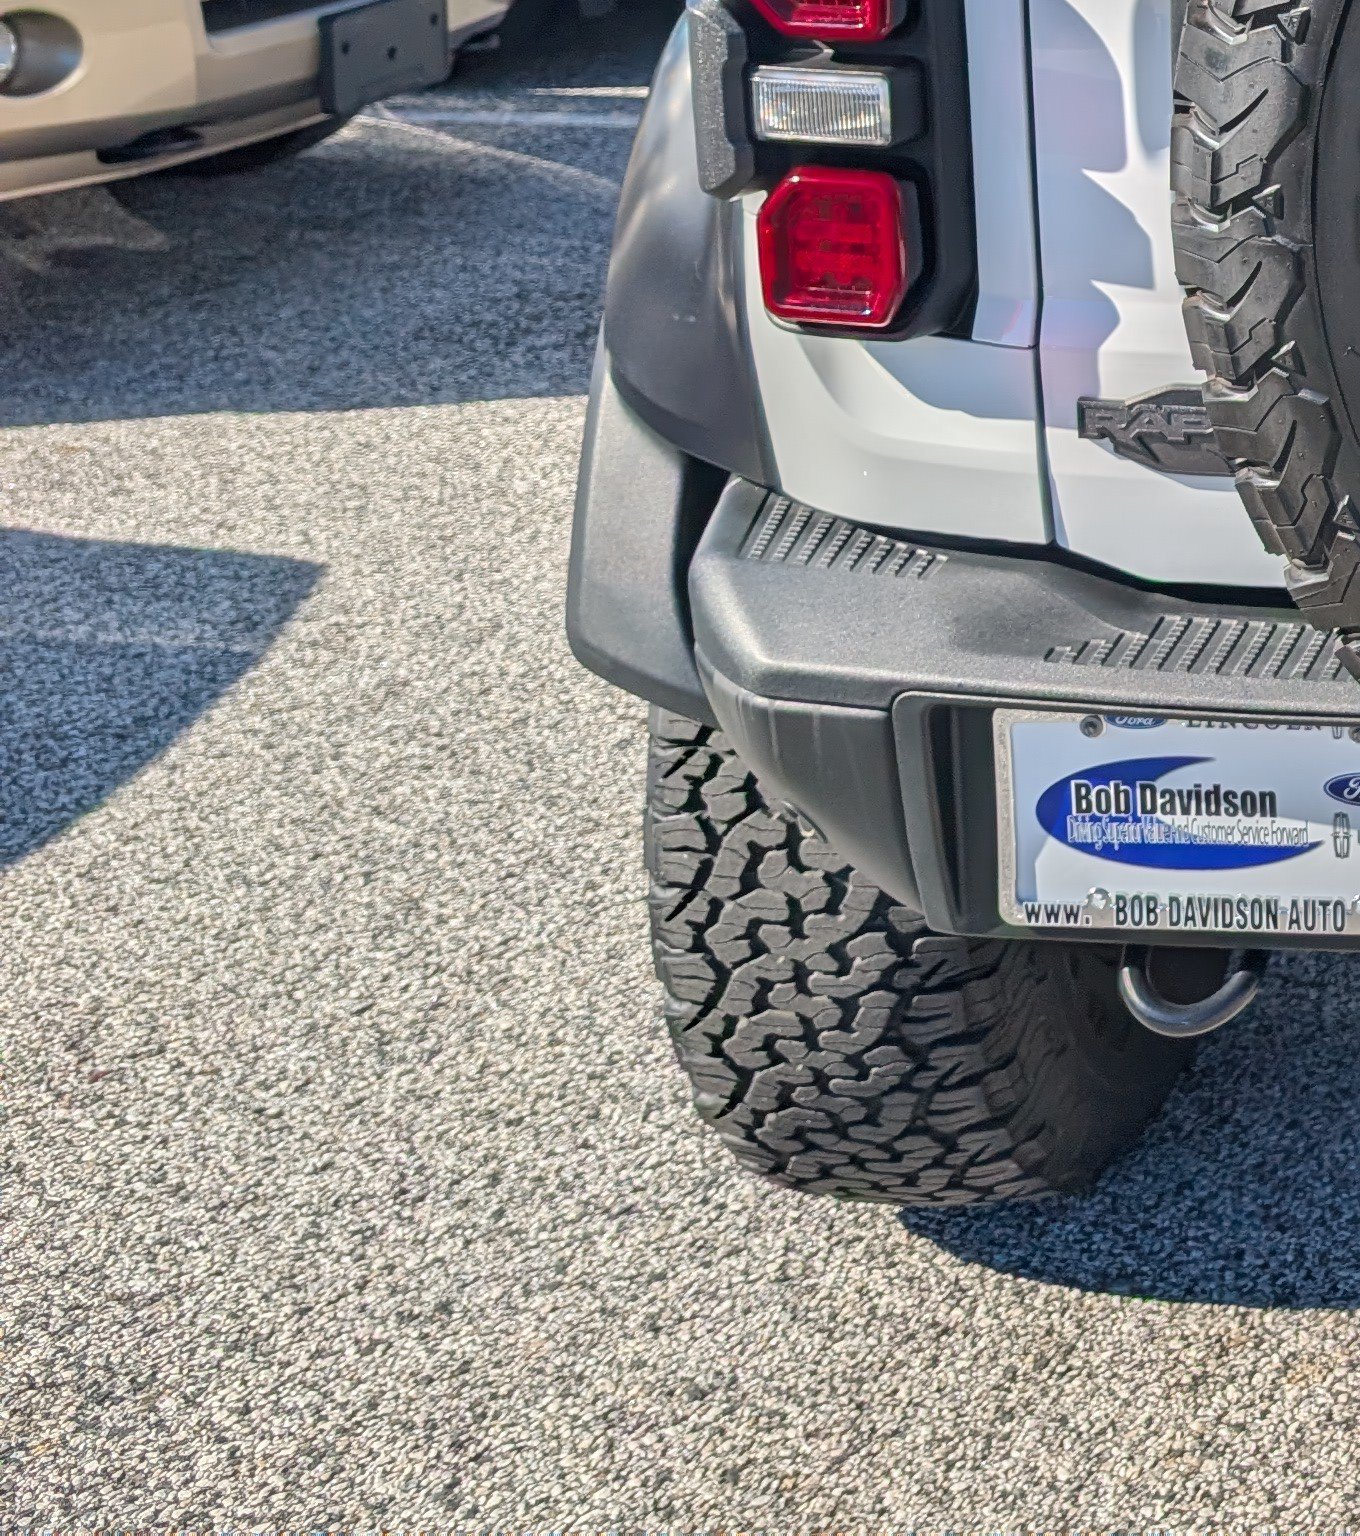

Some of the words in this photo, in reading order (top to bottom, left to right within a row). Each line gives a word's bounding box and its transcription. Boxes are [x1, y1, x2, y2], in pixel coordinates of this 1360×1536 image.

[1074, 780, 1131, 816] Bob
[1140, 782, 1278, 818] Davidson
[1190, 818, 1235, 845] Customer
[1236, 819, 1269, 845] Service
[1270, 820, 1309, 847] Forward
[1024, 902, 1092, 925] www.
[1115, 895, 1158, 927] BOB
[1169, 896, 1279, 931] DAVIDSON
[1288, 899, 1346, 933] AUTO
